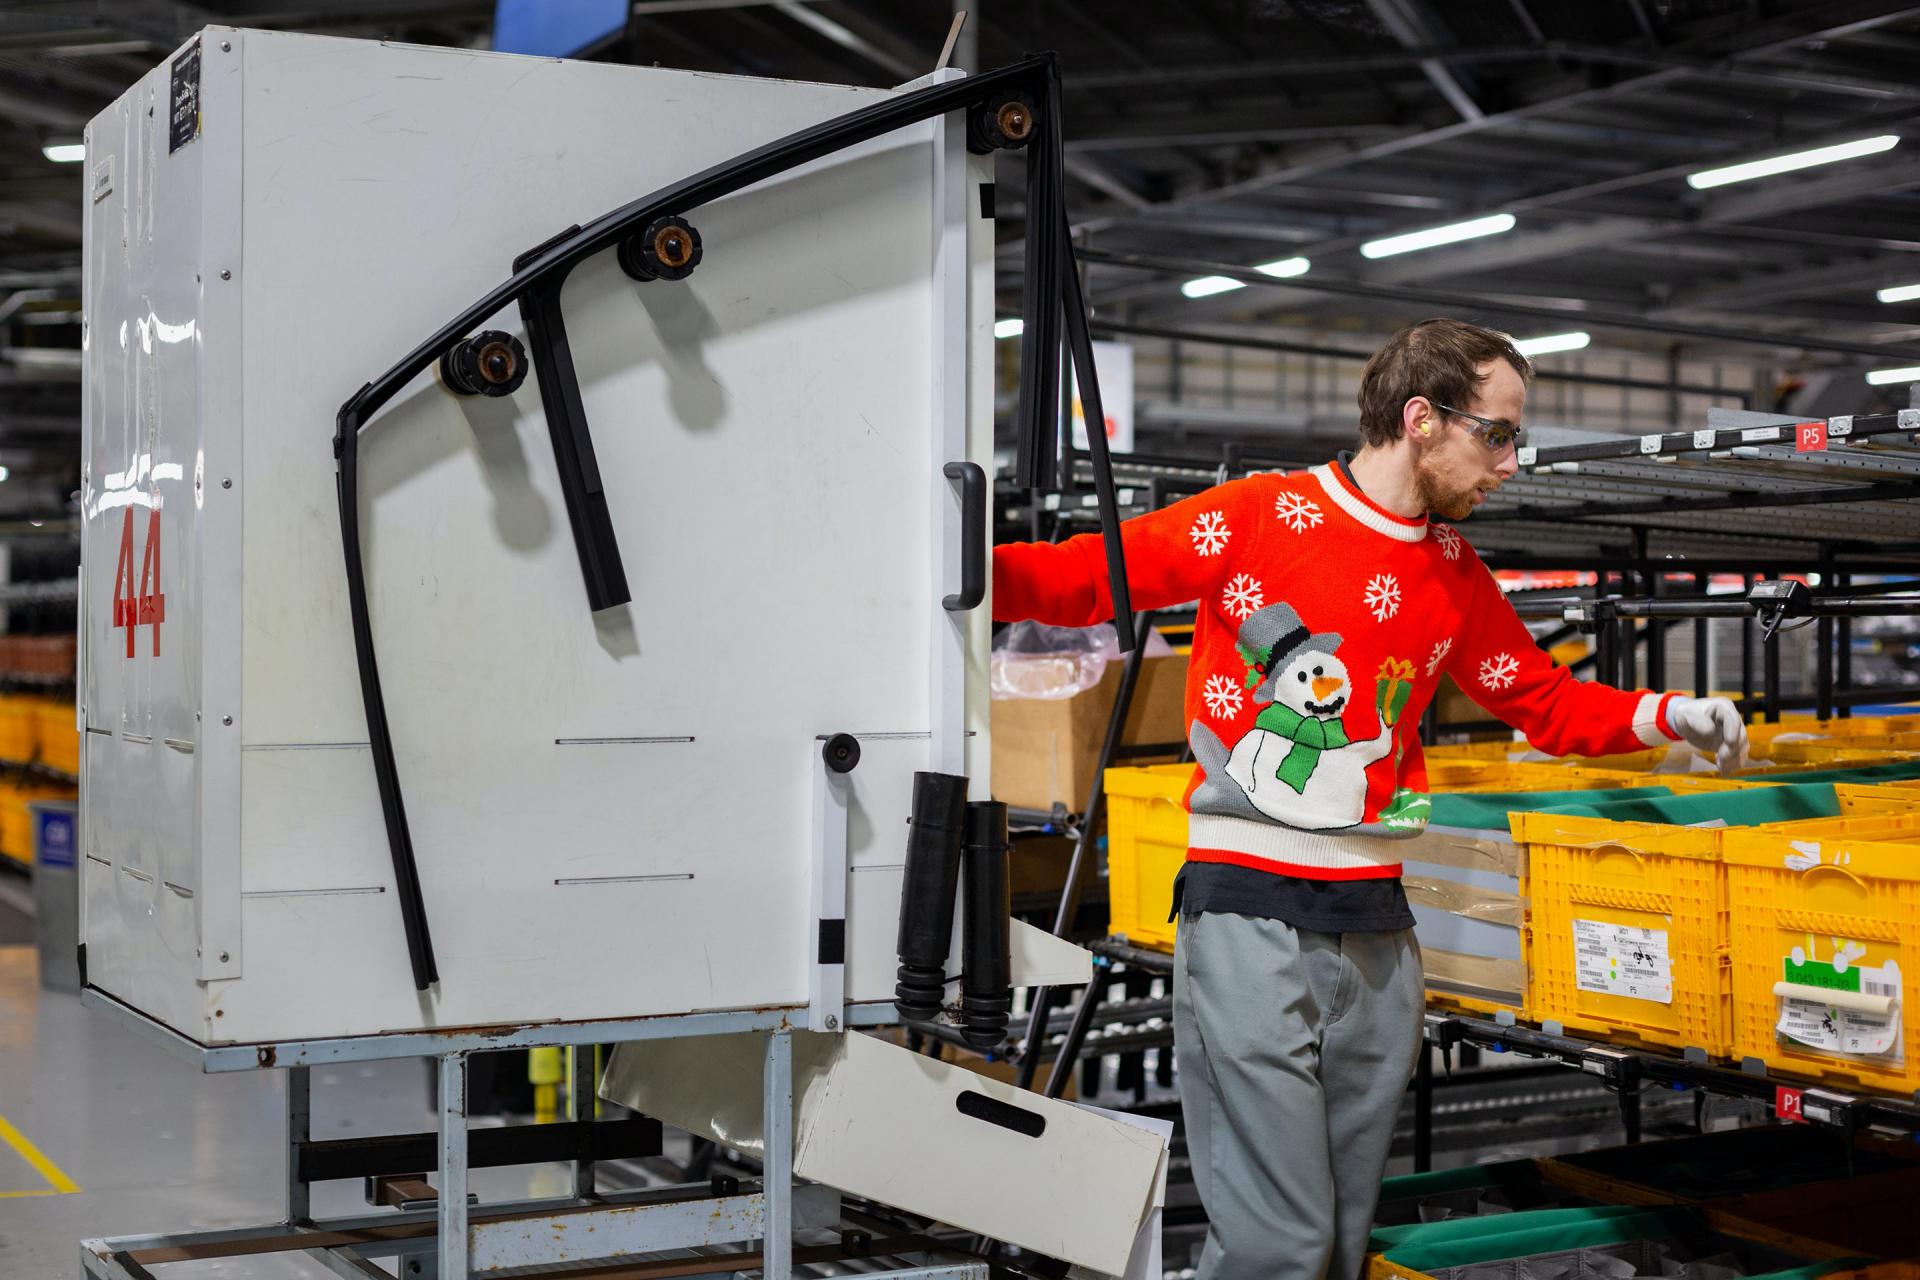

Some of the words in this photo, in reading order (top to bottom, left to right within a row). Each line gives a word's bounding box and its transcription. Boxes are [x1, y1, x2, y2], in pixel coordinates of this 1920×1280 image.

[1803, 428, 1820, 445] P5
[113, 492, 165, 658] 44
[1783, 1093, 1802, 1114] P1
